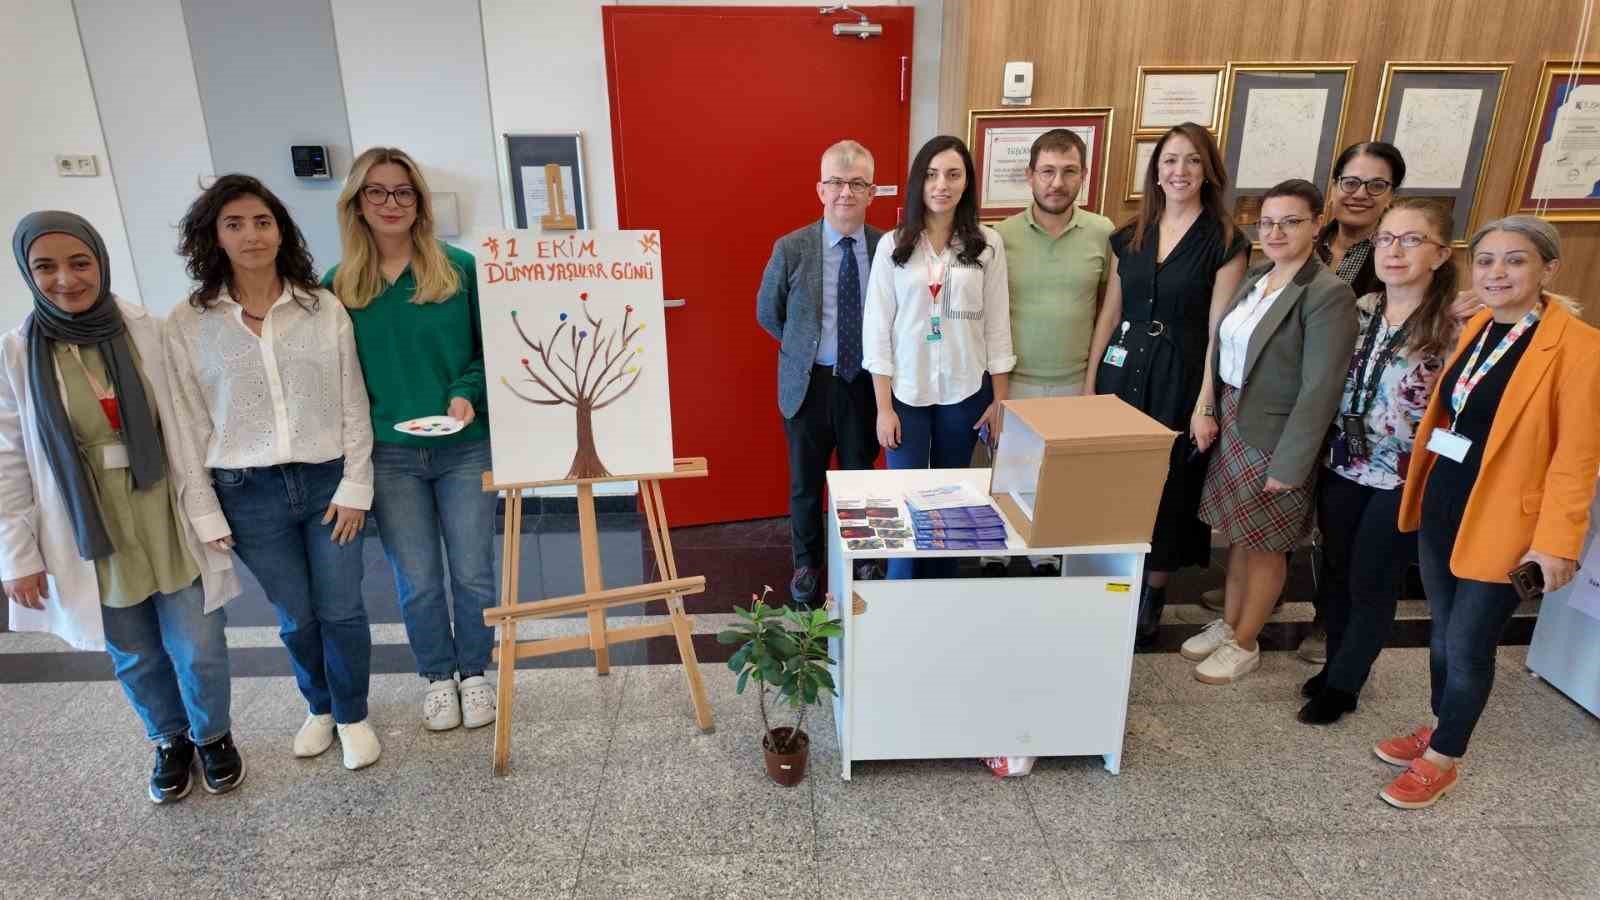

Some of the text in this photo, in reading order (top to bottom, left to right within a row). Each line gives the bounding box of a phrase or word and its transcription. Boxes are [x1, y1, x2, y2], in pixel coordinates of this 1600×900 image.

[506, 235, 598, 258] 1 EKİM
[484, 261, 544, 284] DÜNYA
[611, 261, 654, 281] GÜNÜ
